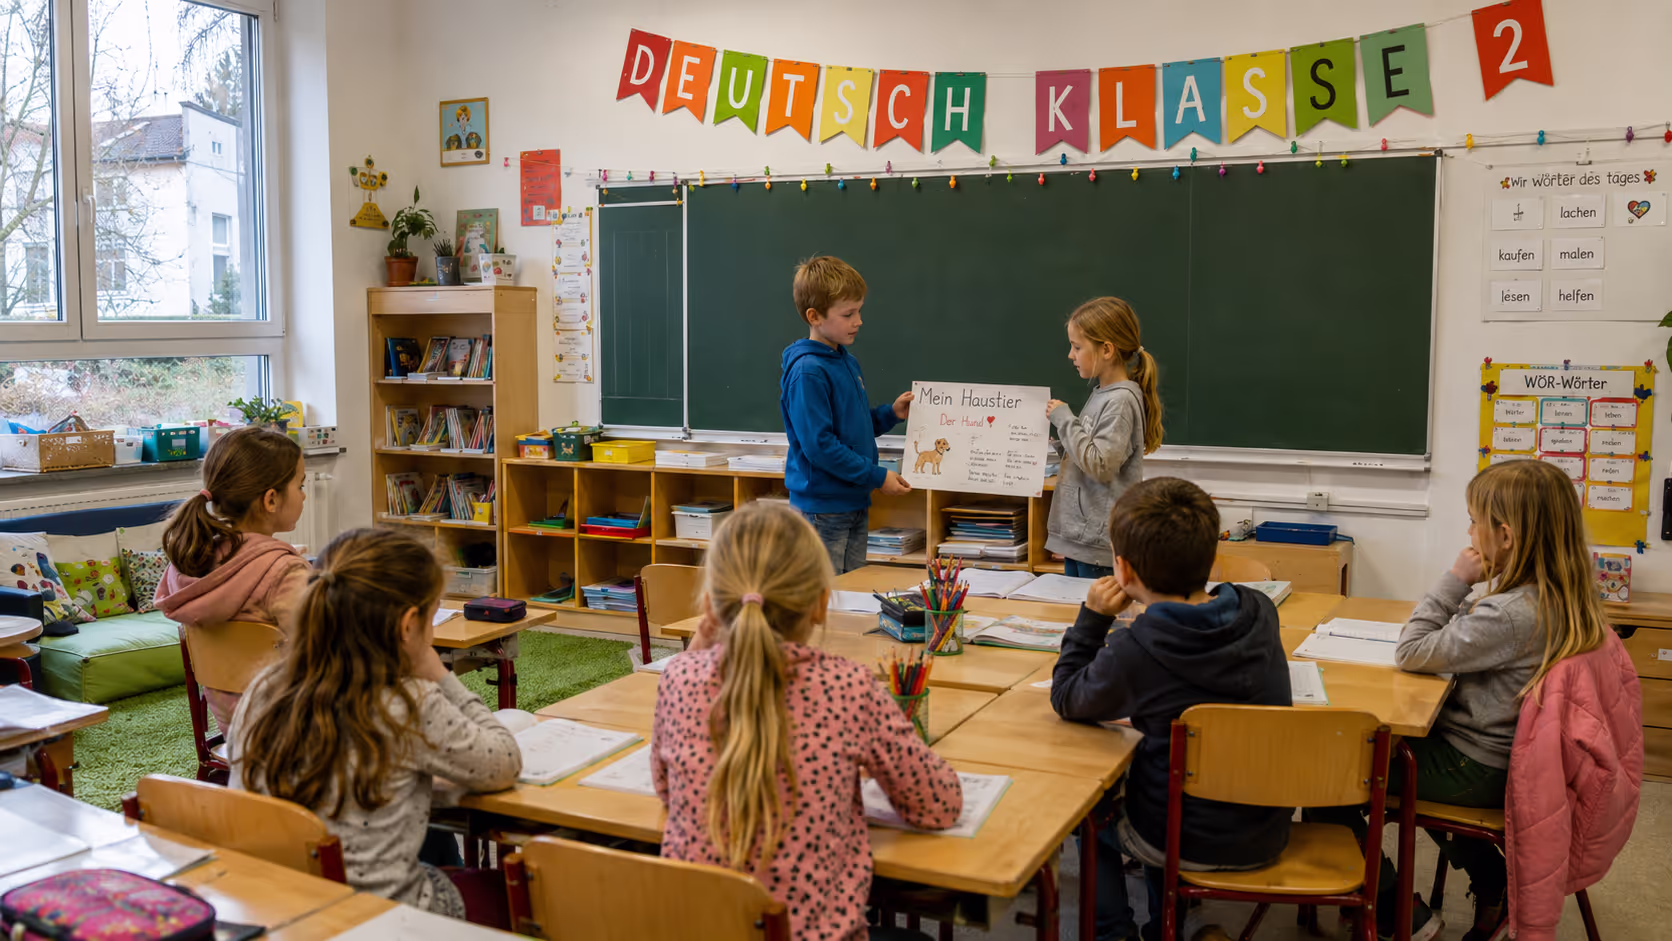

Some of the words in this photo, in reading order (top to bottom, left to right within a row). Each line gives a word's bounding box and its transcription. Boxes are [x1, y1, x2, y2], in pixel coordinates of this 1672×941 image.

[629, 43, 971, 132] DEUTSCH
[1048, 44, 1410, 132] KLASSE
[1492, 18, 1529, 74] 2
[1510, 177, 1528, 188] Wir
[1579, 172, 1601, 186] des
[1606, 171, 1640, 187] tages
[1560, 206, 1597, 219] lachen
[1498, 248, 1535, 263] kaufen
[1559, 247, 1594, 260] malen
[1558, 288, 1594, 304] helfen
[1524, 374, 1608, 390] WÖR-Wörter
[919, 387, 952, 405] Mein
[961, 388, 1022, 408] Haustier
[940, 413, 956, 426] Der
[961, 415, 984, 428] Hund
